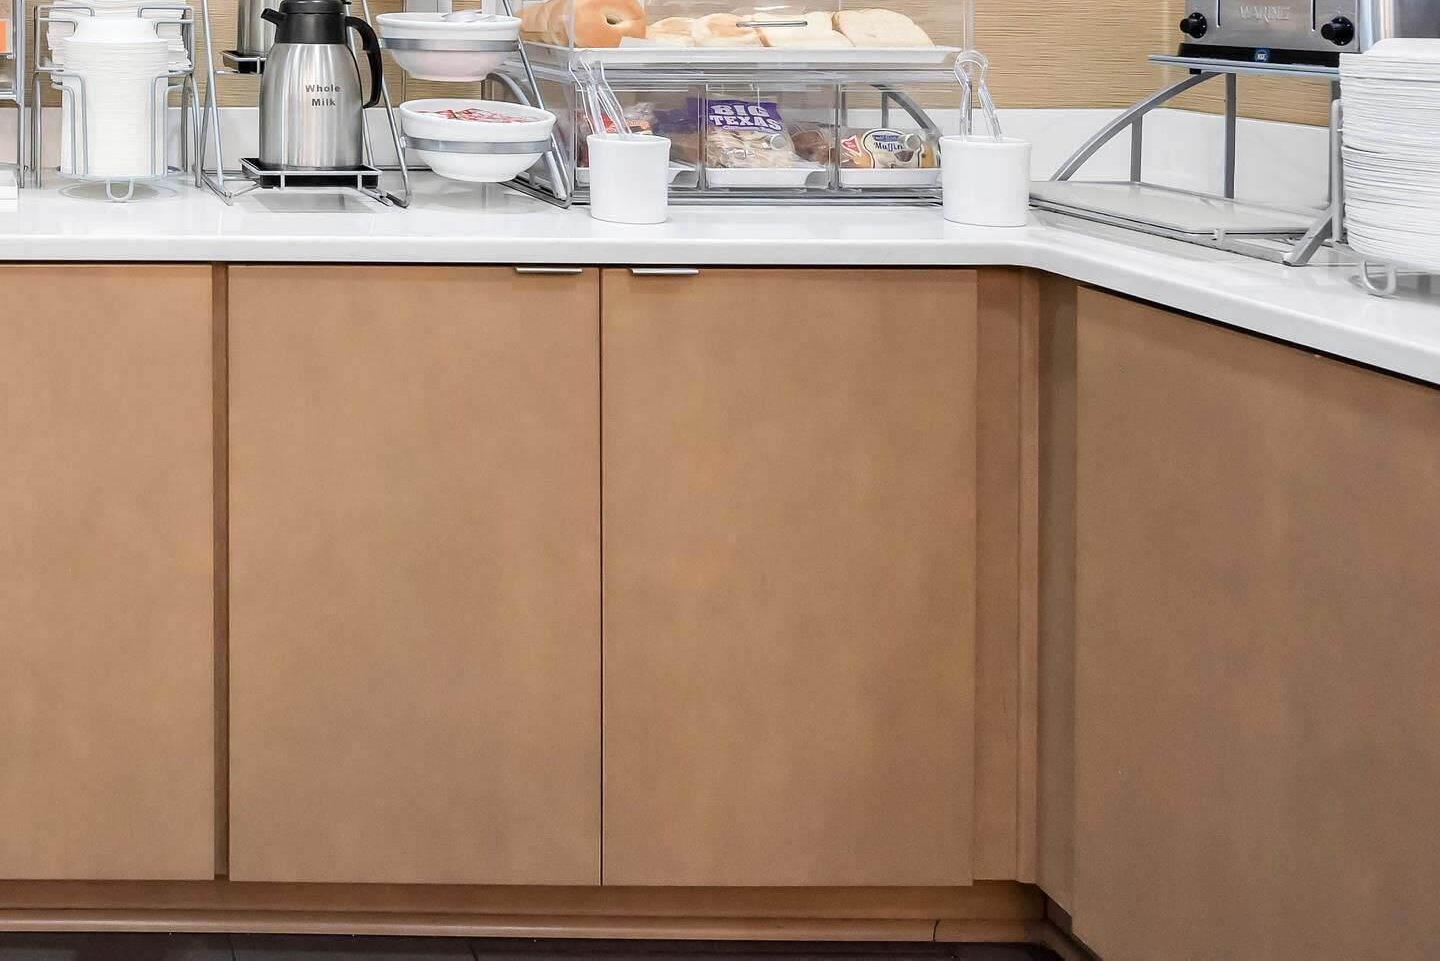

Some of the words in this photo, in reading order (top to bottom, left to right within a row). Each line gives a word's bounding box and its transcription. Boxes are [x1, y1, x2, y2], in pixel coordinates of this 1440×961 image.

[305, 84, 341, 93] Whole
[311, 98, 336, 107] Milk
[711, 104, 770, 118] BIG
[709, 115, 782, 131] TEXAS
